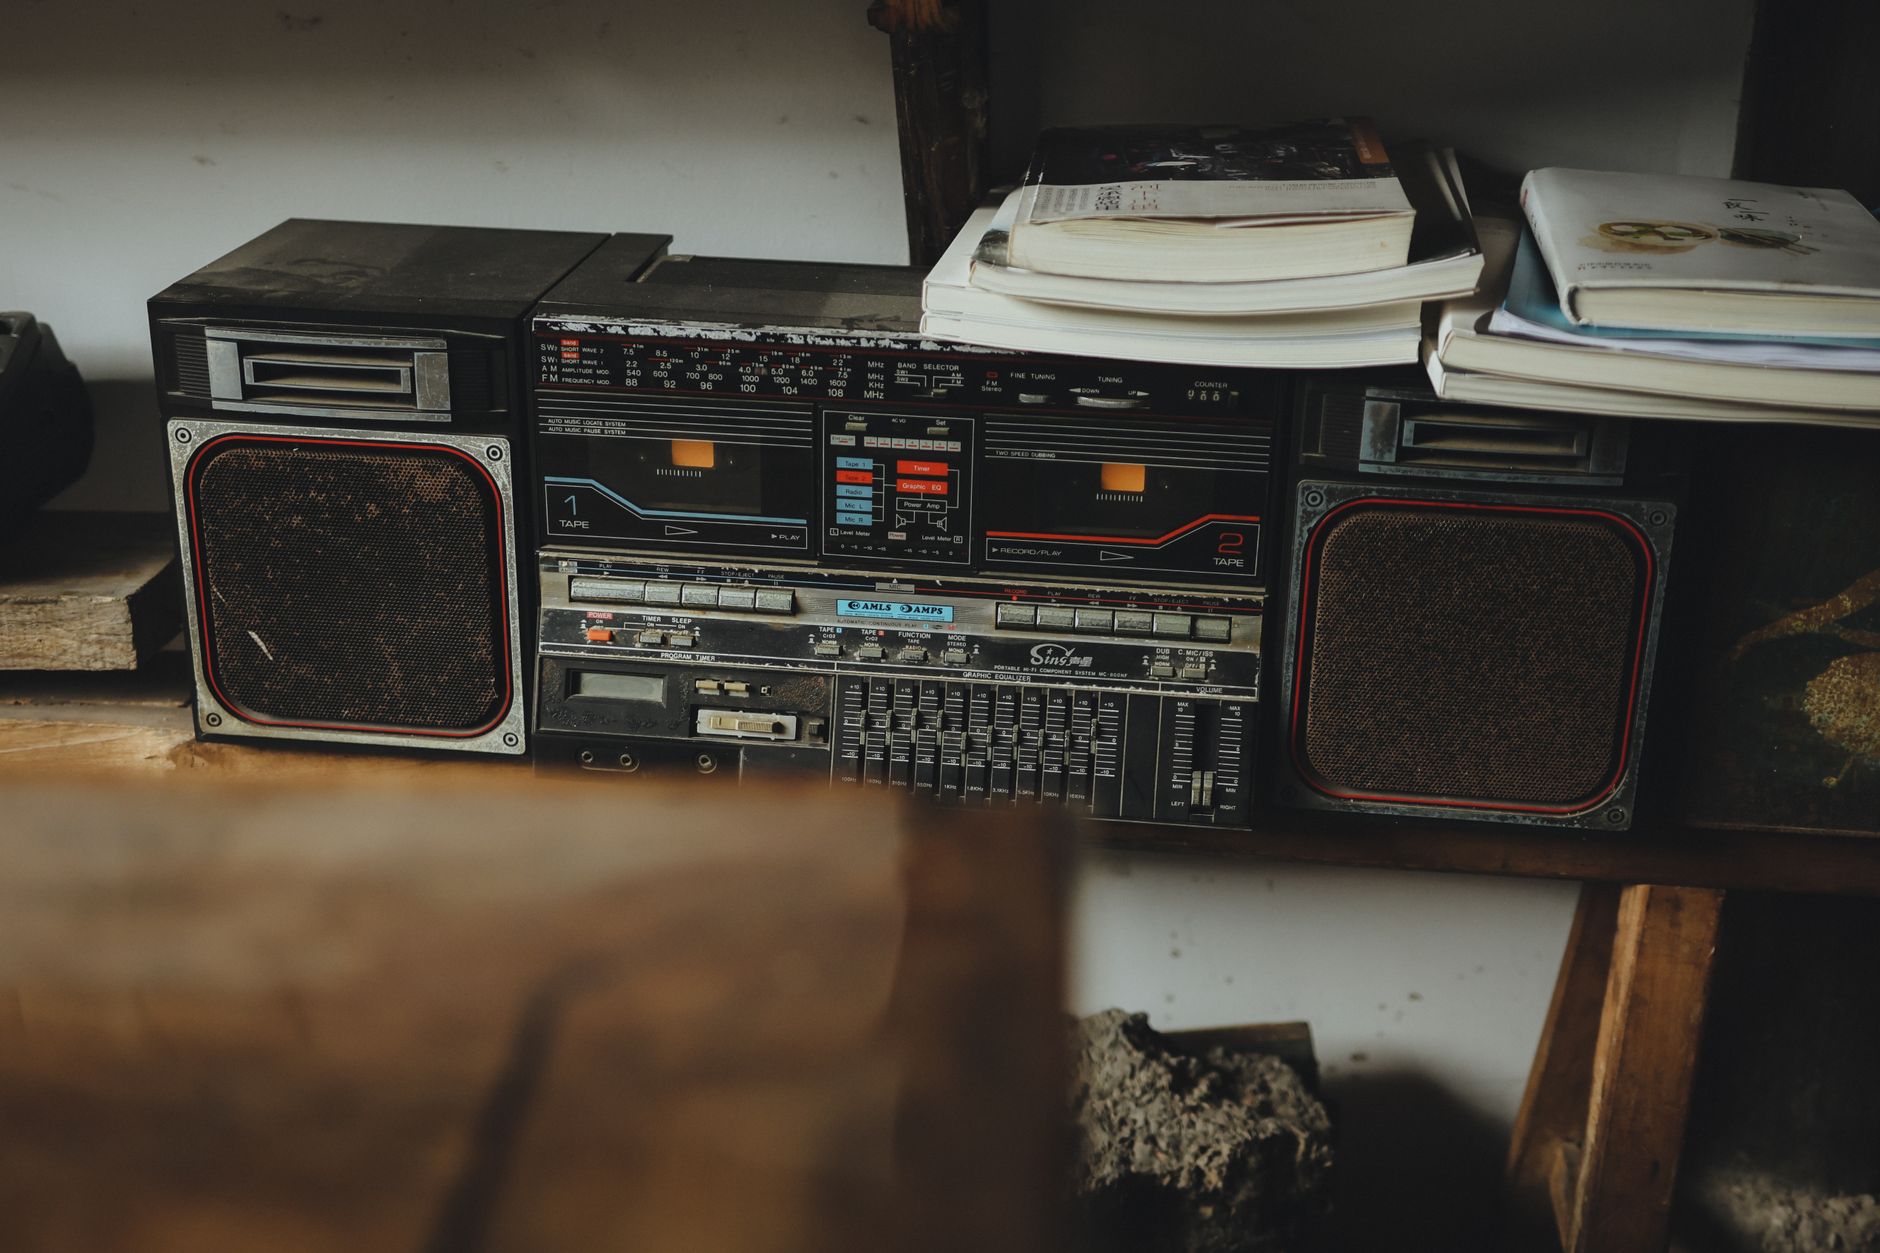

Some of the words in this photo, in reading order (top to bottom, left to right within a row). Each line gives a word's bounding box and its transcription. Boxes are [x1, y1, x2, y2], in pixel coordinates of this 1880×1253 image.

[623, 348, 634, 356] 7.5
[1098, 376, 1122, 384] TUNING
[1195, 381, 1227, 389] COUNTER
[626, 379, 638, 387] 88
[664, 380, 676, 388] 92
[700, 382, 713, 390] 96
[740, 384, 756, 392] 100
[782, 387, 797, 395] 104
[828, 389, 843, 397] 108
[864, 390, 884, 399] MHz
[564, 495, 576, 516] 1
[560, 520, 589, 529] TAPE
[1217, 531, 1244, 555] 2
[1000, 547, 1062, 557] RECORD/PLAY
[1213, 557, 1244, 567] TAPE
[862, 602, 891, 611] AMLS
[914, 606, 943, 615] AMPS
[661, 652, 692, 660] PROGRAM
[994, 673, 1031, 683] EQUALIZER
[1075, 669, 1096, 677] SYSTEM
